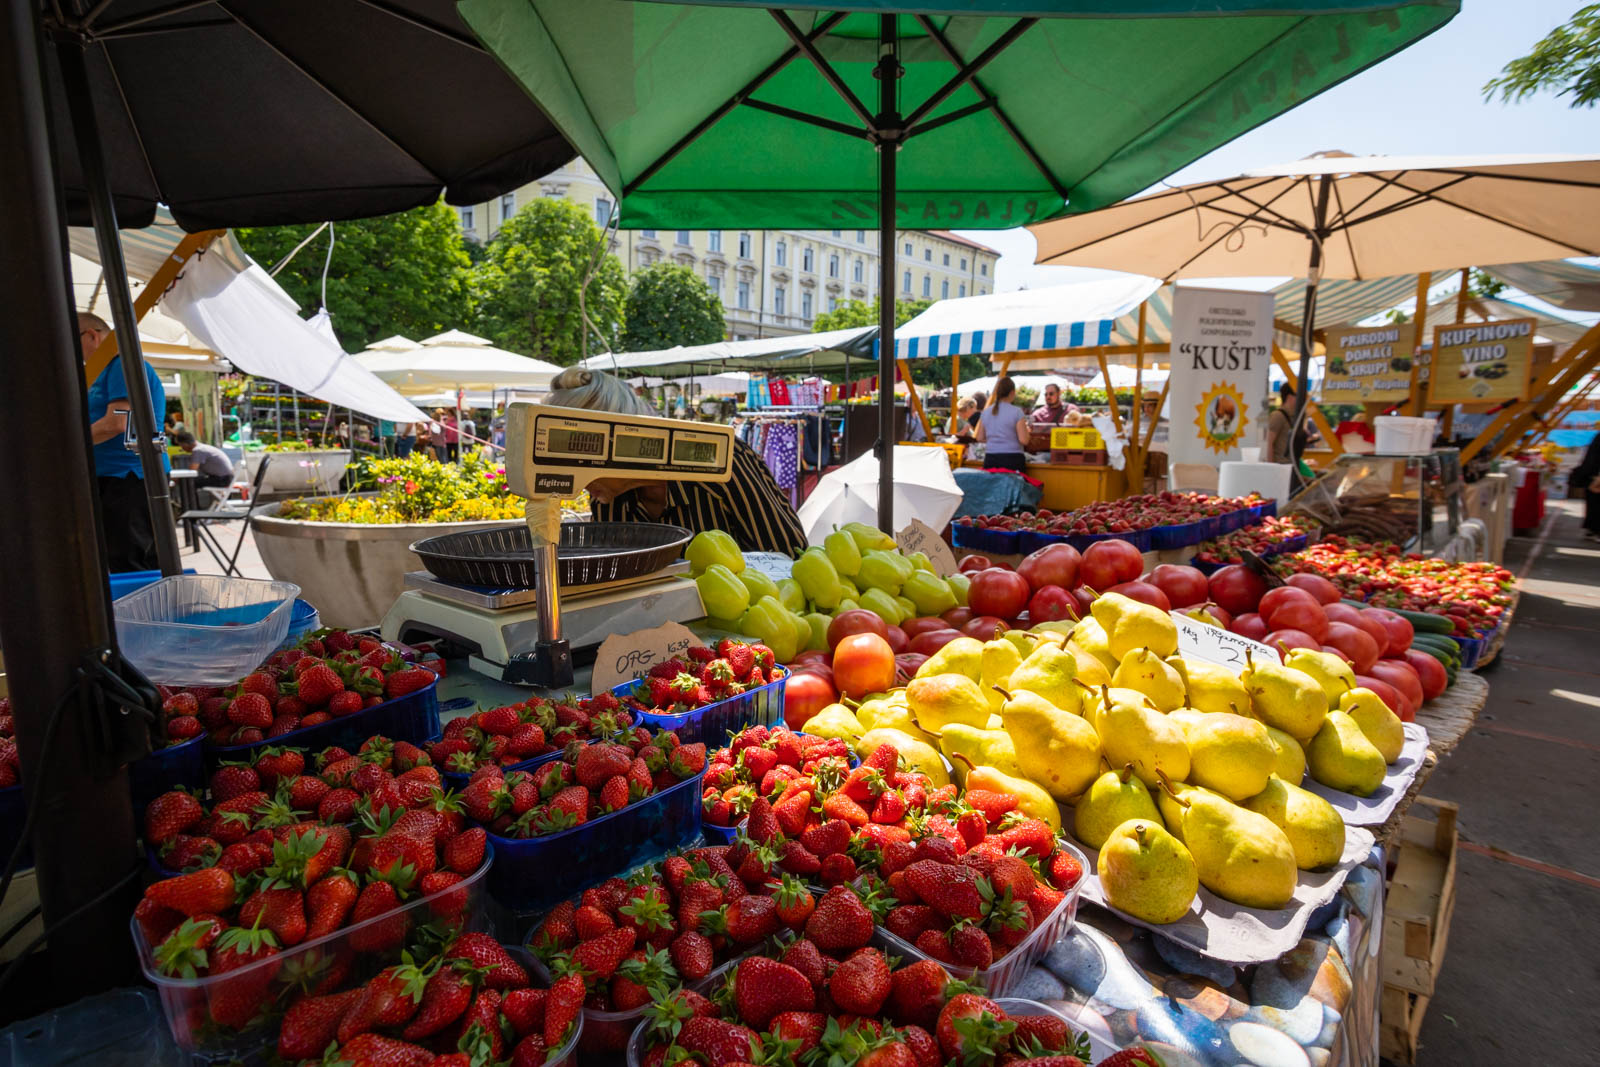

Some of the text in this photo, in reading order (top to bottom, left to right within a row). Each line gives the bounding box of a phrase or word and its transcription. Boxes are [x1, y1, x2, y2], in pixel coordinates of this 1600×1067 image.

[1340, 328, 1399, 348] PRIRODNI
[1440, 322, 1533, 347] KUPINOVO
[1462, 344, 1507, 364] VINO
[538, 478, 571, 488] digitron
[616, 649, 657, 674] OPG
[1219, 646, 1245, 666] 2
